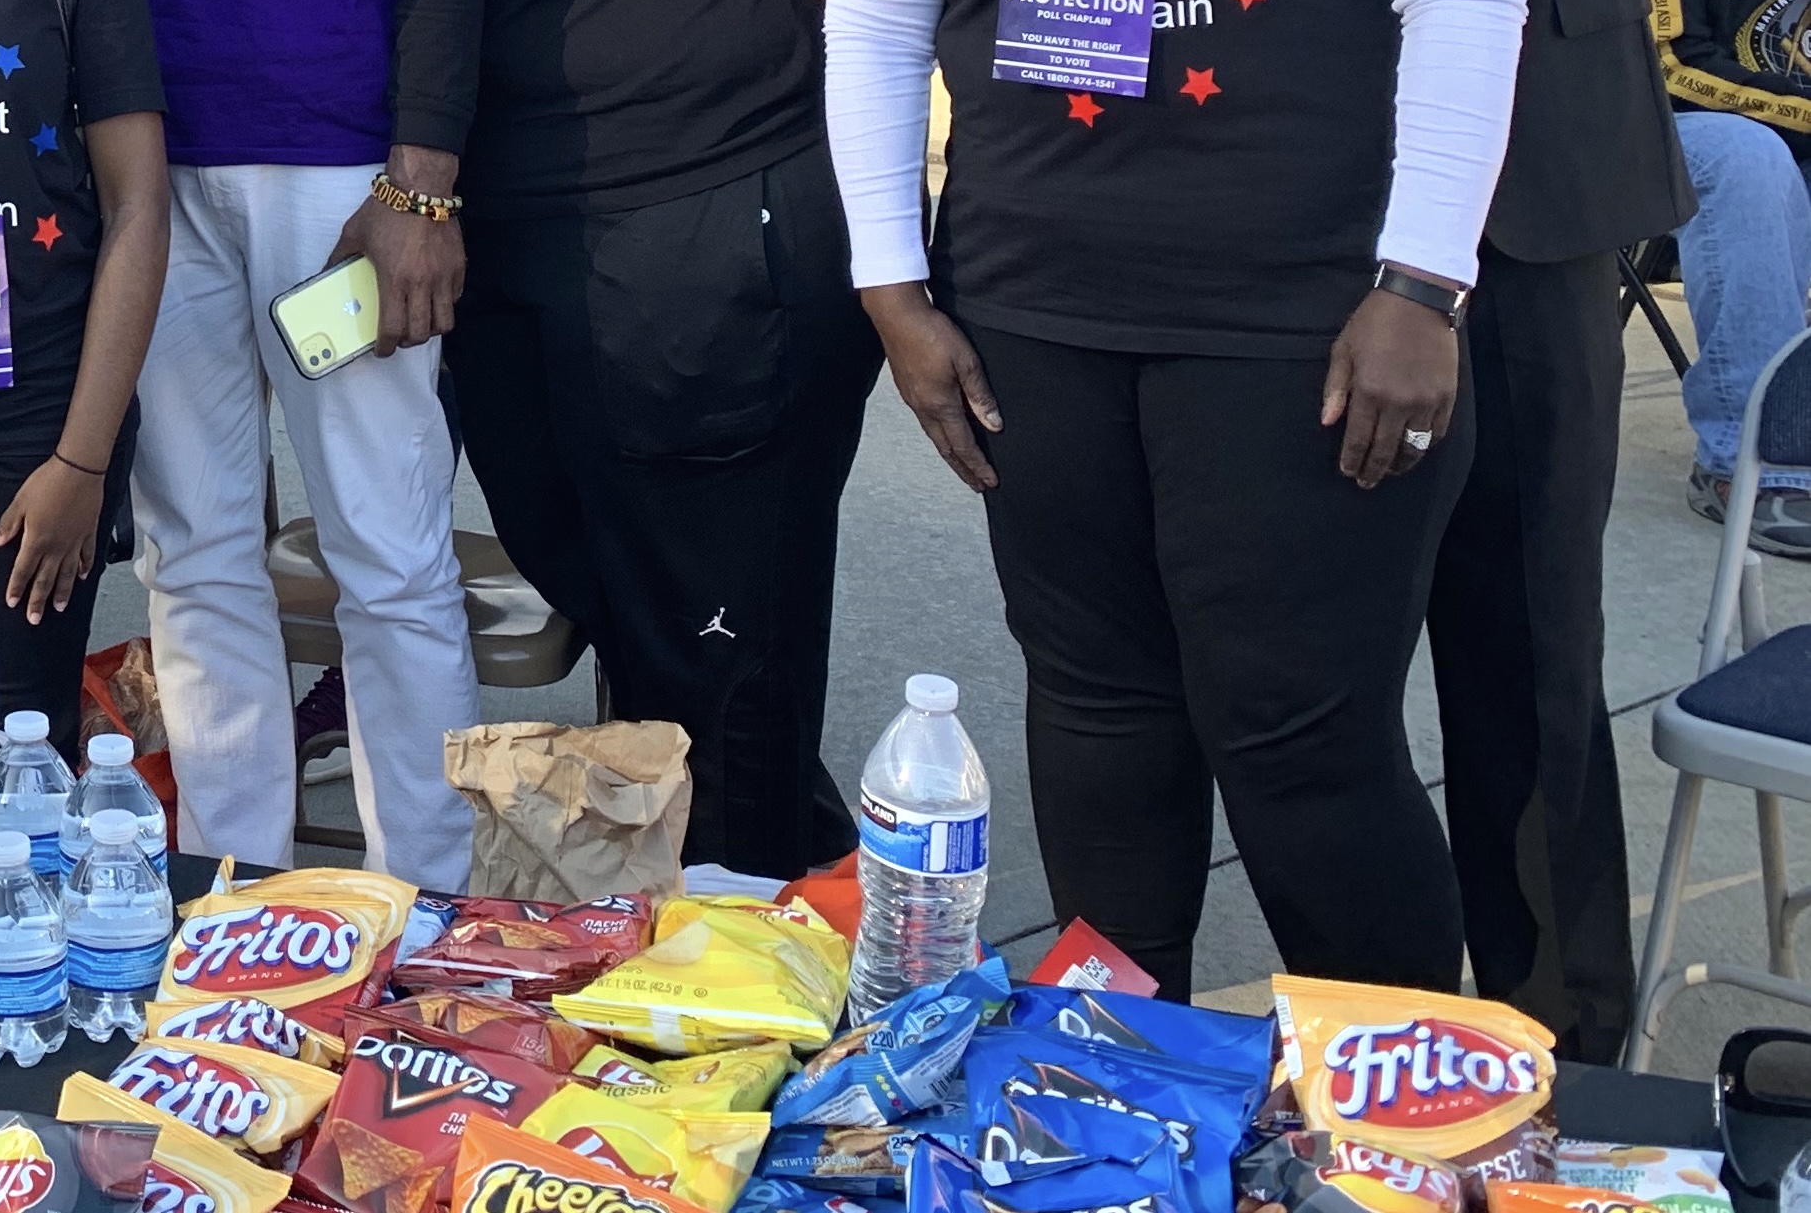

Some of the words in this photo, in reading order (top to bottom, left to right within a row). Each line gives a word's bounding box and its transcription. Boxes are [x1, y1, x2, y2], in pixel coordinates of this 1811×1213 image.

[1037, 9, 1060, 21] POLL
[1063, 12, 1112, 27] CHAPLAIN
[1021, 32, 1042, 44] YOU
[1044, 36, 1070, 47] HAVE
[1072, 39, 1090, 49] THE
[1092, 41, 1122, 53] RIGHT
[1049, 54, 1063, 64] TO
[1065, 57, 1090, 68] VOTE
[1021, 69, 1044, 81] CALL
[1047, 73, 1116, 90] 1800-874-1541
[1674, 74, 1719, 99] MASON
[173, 905, 360, 984] Fritos
[227, 971, 283, 983] BRAND
[615, 979, 620, 989] 1
[634, 980, 648, 990] OZ.
[649, 980, 672, 994] (42.5
[673, 984, 683, 996] g)
[870, 1032, 895, 1049] 220
[353, 1035, 516, 1105] Doritos
[1324, 1019, 1537, 1119] Fritos
[108, 1047, 270, 1136] Fritos
[601, 1083, 672, 1100] lassic
[1408, 1096, 1474, 1116] BRAND
[448, 1111, 468, 1124] NA
[439, 1122, 465, 1135] CHE
[772, 1158, 789, 1168] NET
[790, 1157, 804, 1167] WT
[824, 1155, 836, 1166] OZ
[1467, 1147, 1527, 1184] ESE
[468, 1166, 664, 1213] Cheeto
